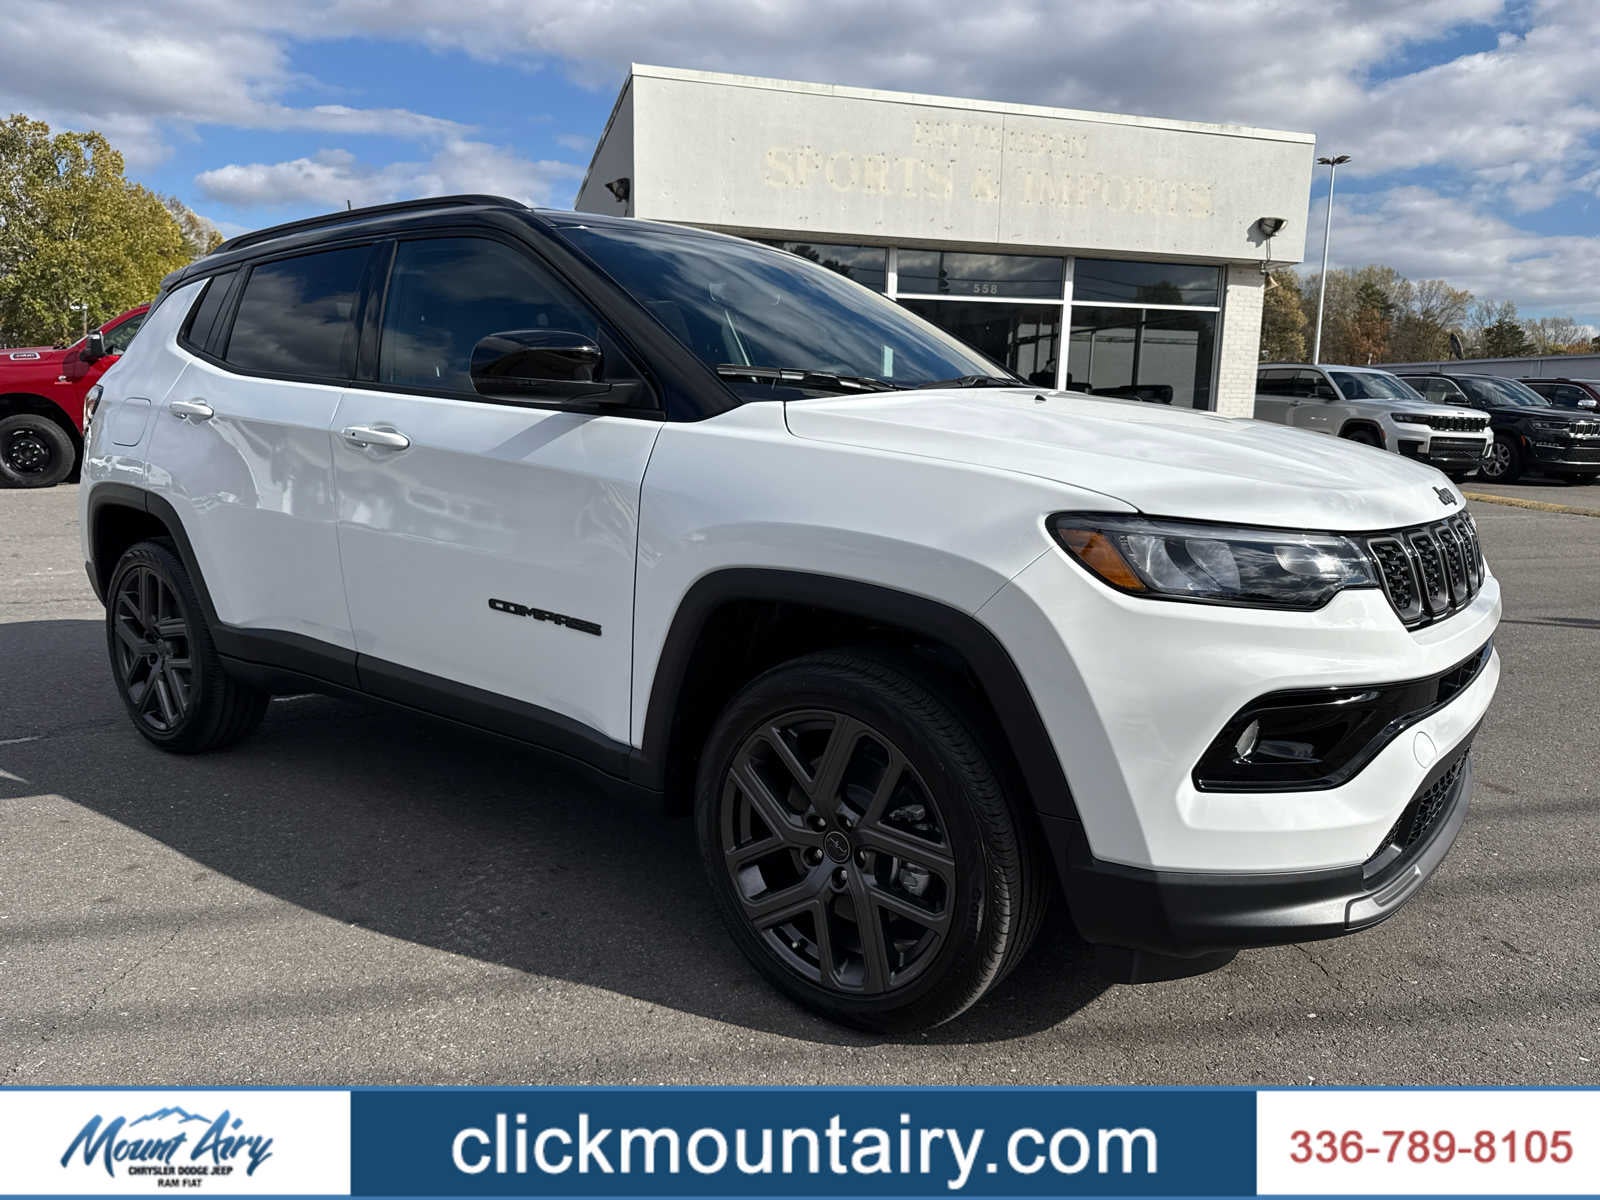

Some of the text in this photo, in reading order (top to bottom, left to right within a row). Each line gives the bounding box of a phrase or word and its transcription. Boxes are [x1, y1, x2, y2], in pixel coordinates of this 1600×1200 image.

[764, 147, 954, 200] SPORTS
[1022, 169, 1214, 217] IMPORTS
[973, 283, 998, 294] 558
[488, 598, 602, 636] COMPASS
